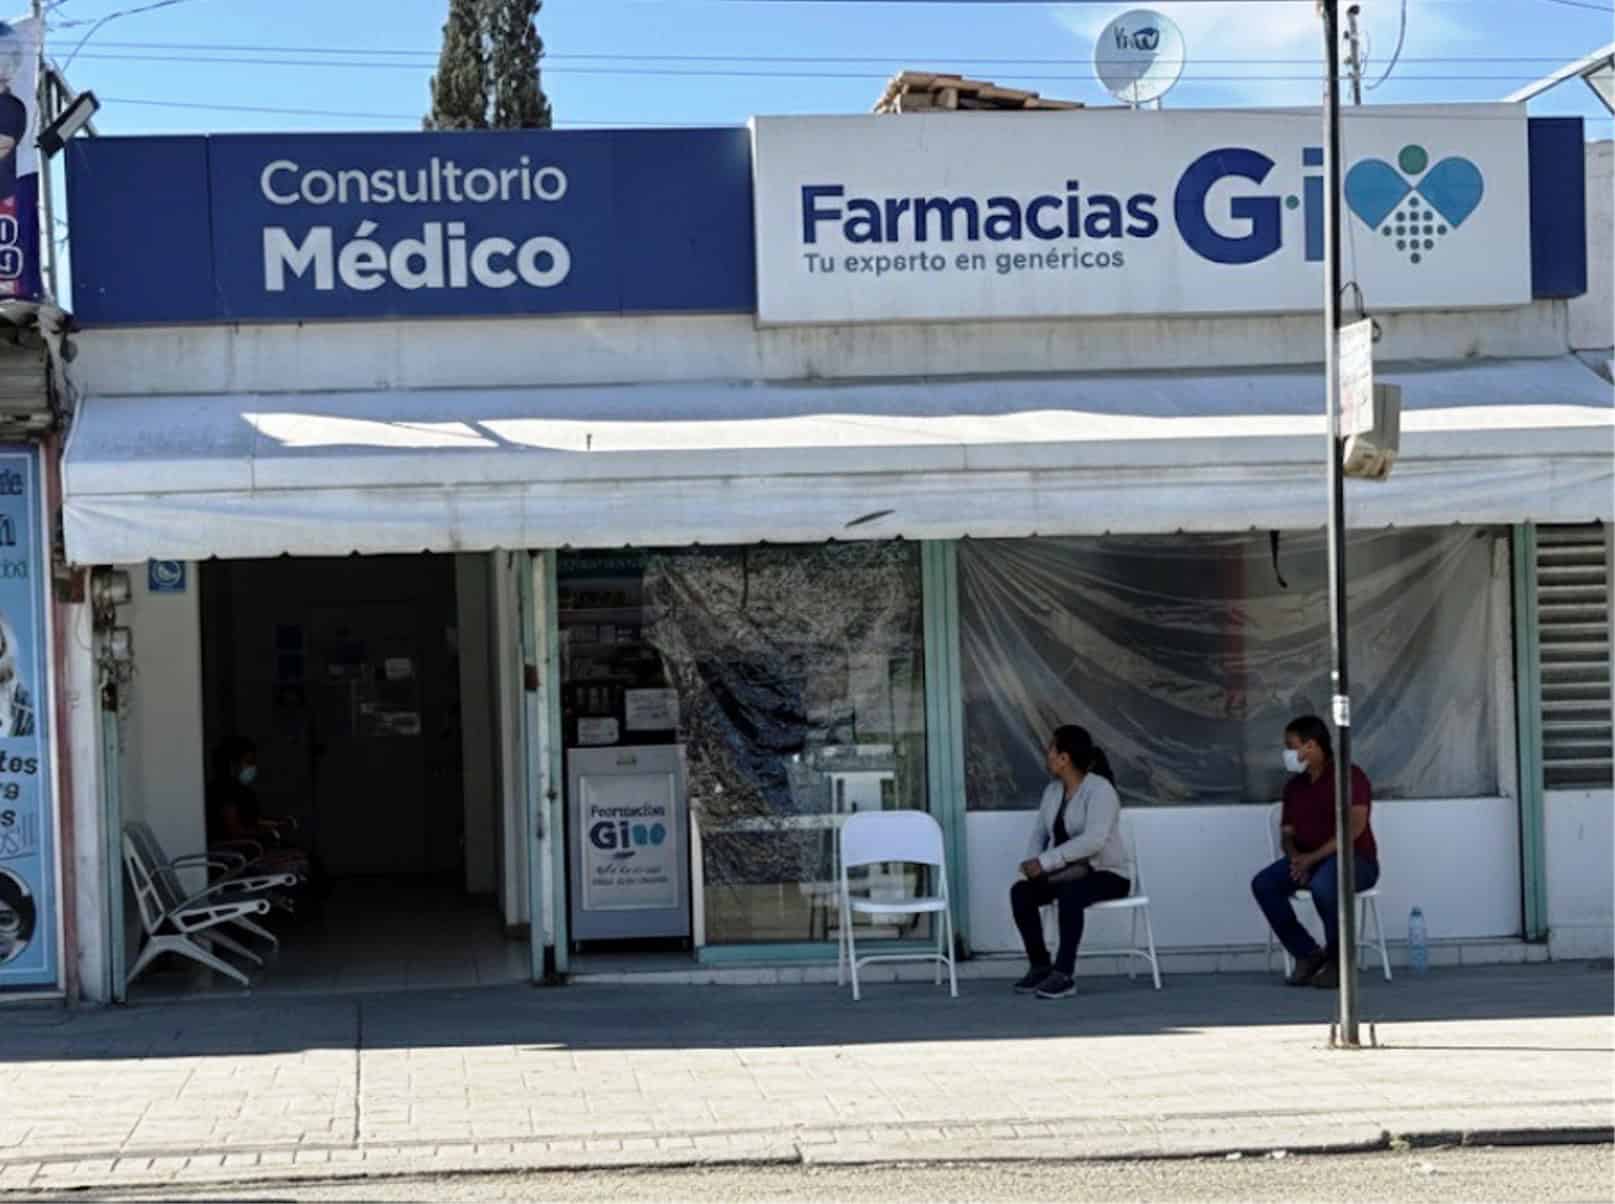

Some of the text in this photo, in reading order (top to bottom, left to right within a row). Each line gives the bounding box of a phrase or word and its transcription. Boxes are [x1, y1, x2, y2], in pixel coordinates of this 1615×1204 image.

[260, 155, 568, 205] Consultorio
[801, 180, 1160, 244] Farmacias
[263, 219, 571, 292] Médico
[803, 252, 835, 273] Tu
[955, 253, 987, 271] en
[995, 247, 1126, 275] genéricos
